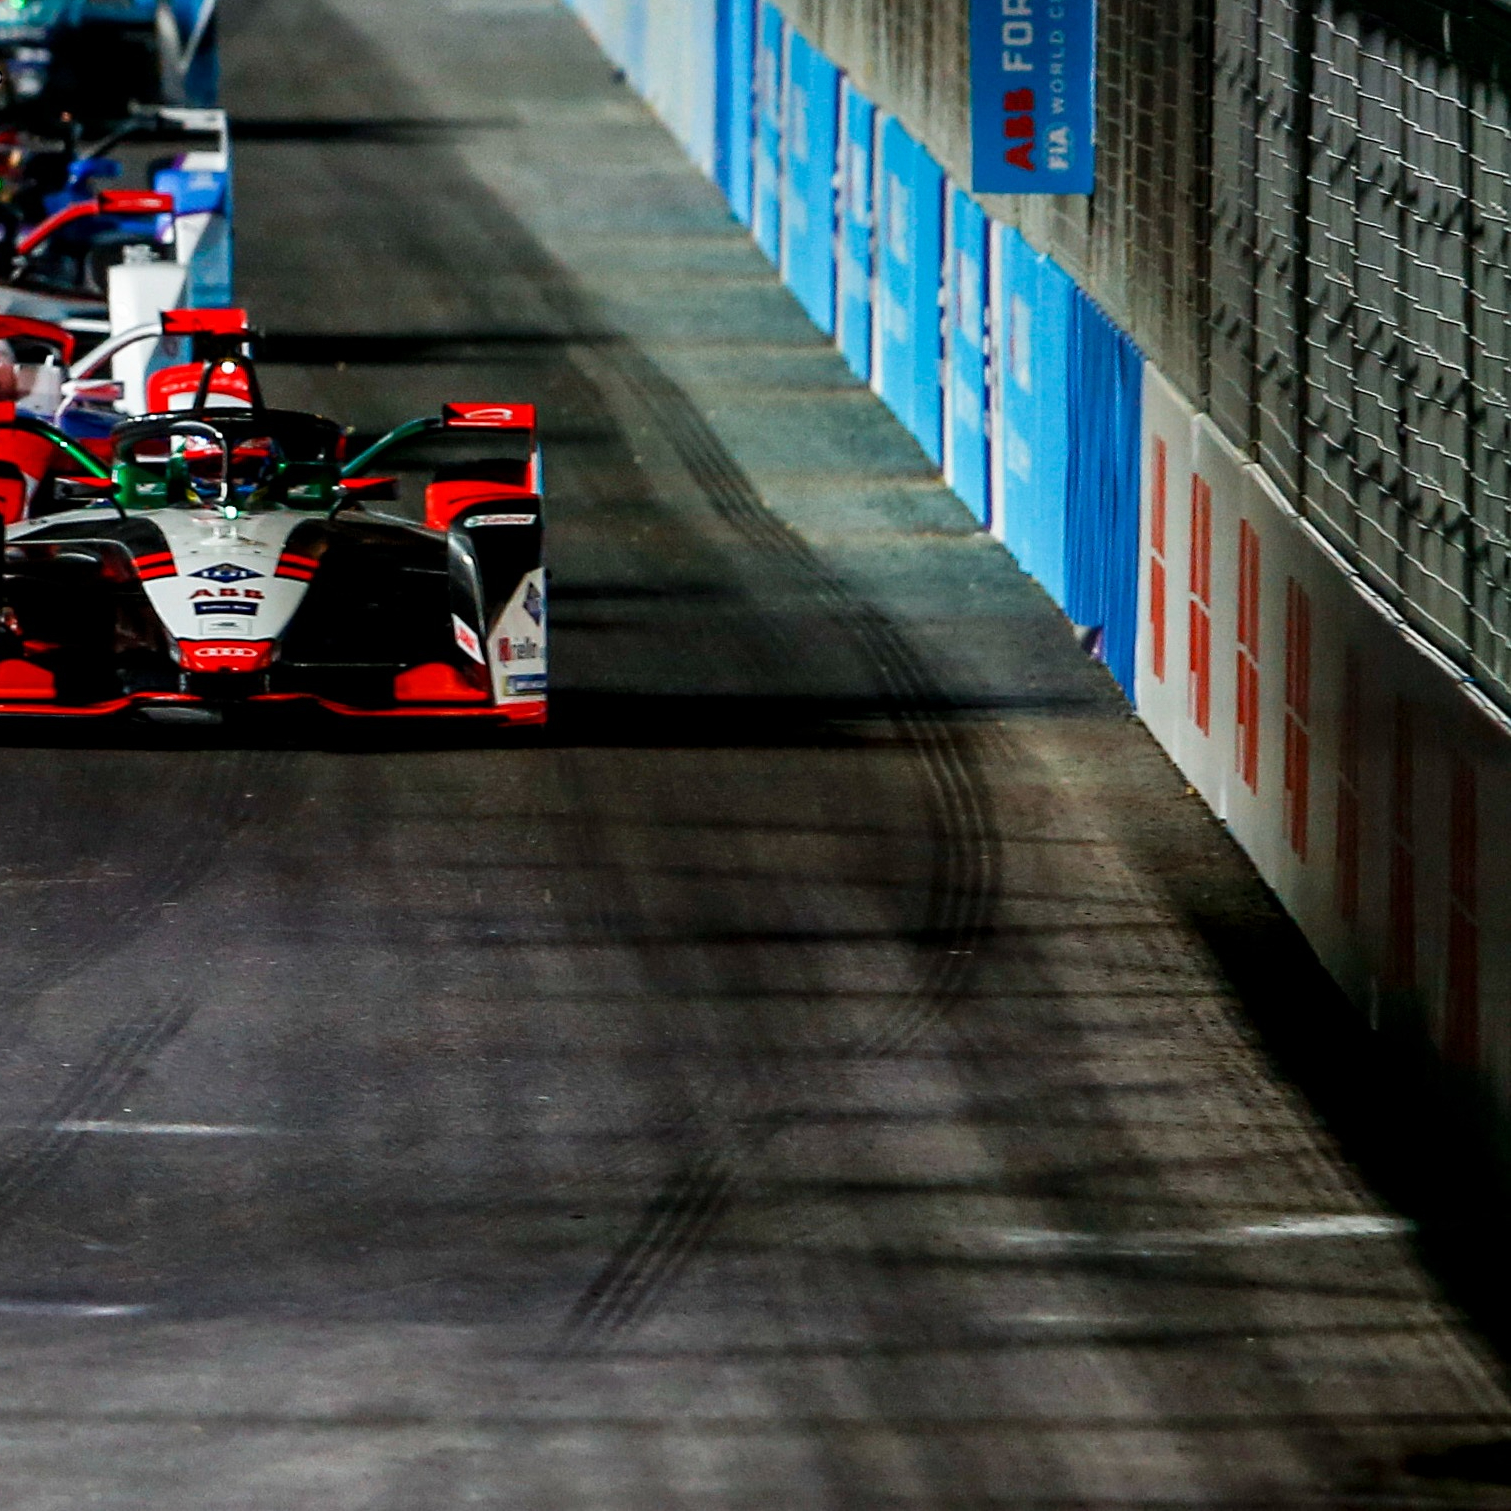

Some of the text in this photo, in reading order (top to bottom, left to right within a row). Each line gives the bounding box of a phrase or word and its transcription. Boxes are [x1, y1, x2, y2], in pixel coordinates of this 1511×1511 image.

[1048, 31, 1066, 116] WORLD
[1003, 87, 1035, 171] ABB
[1047, 125, 1070, 171] FIA
[189, 588, 265, 600] ABB
